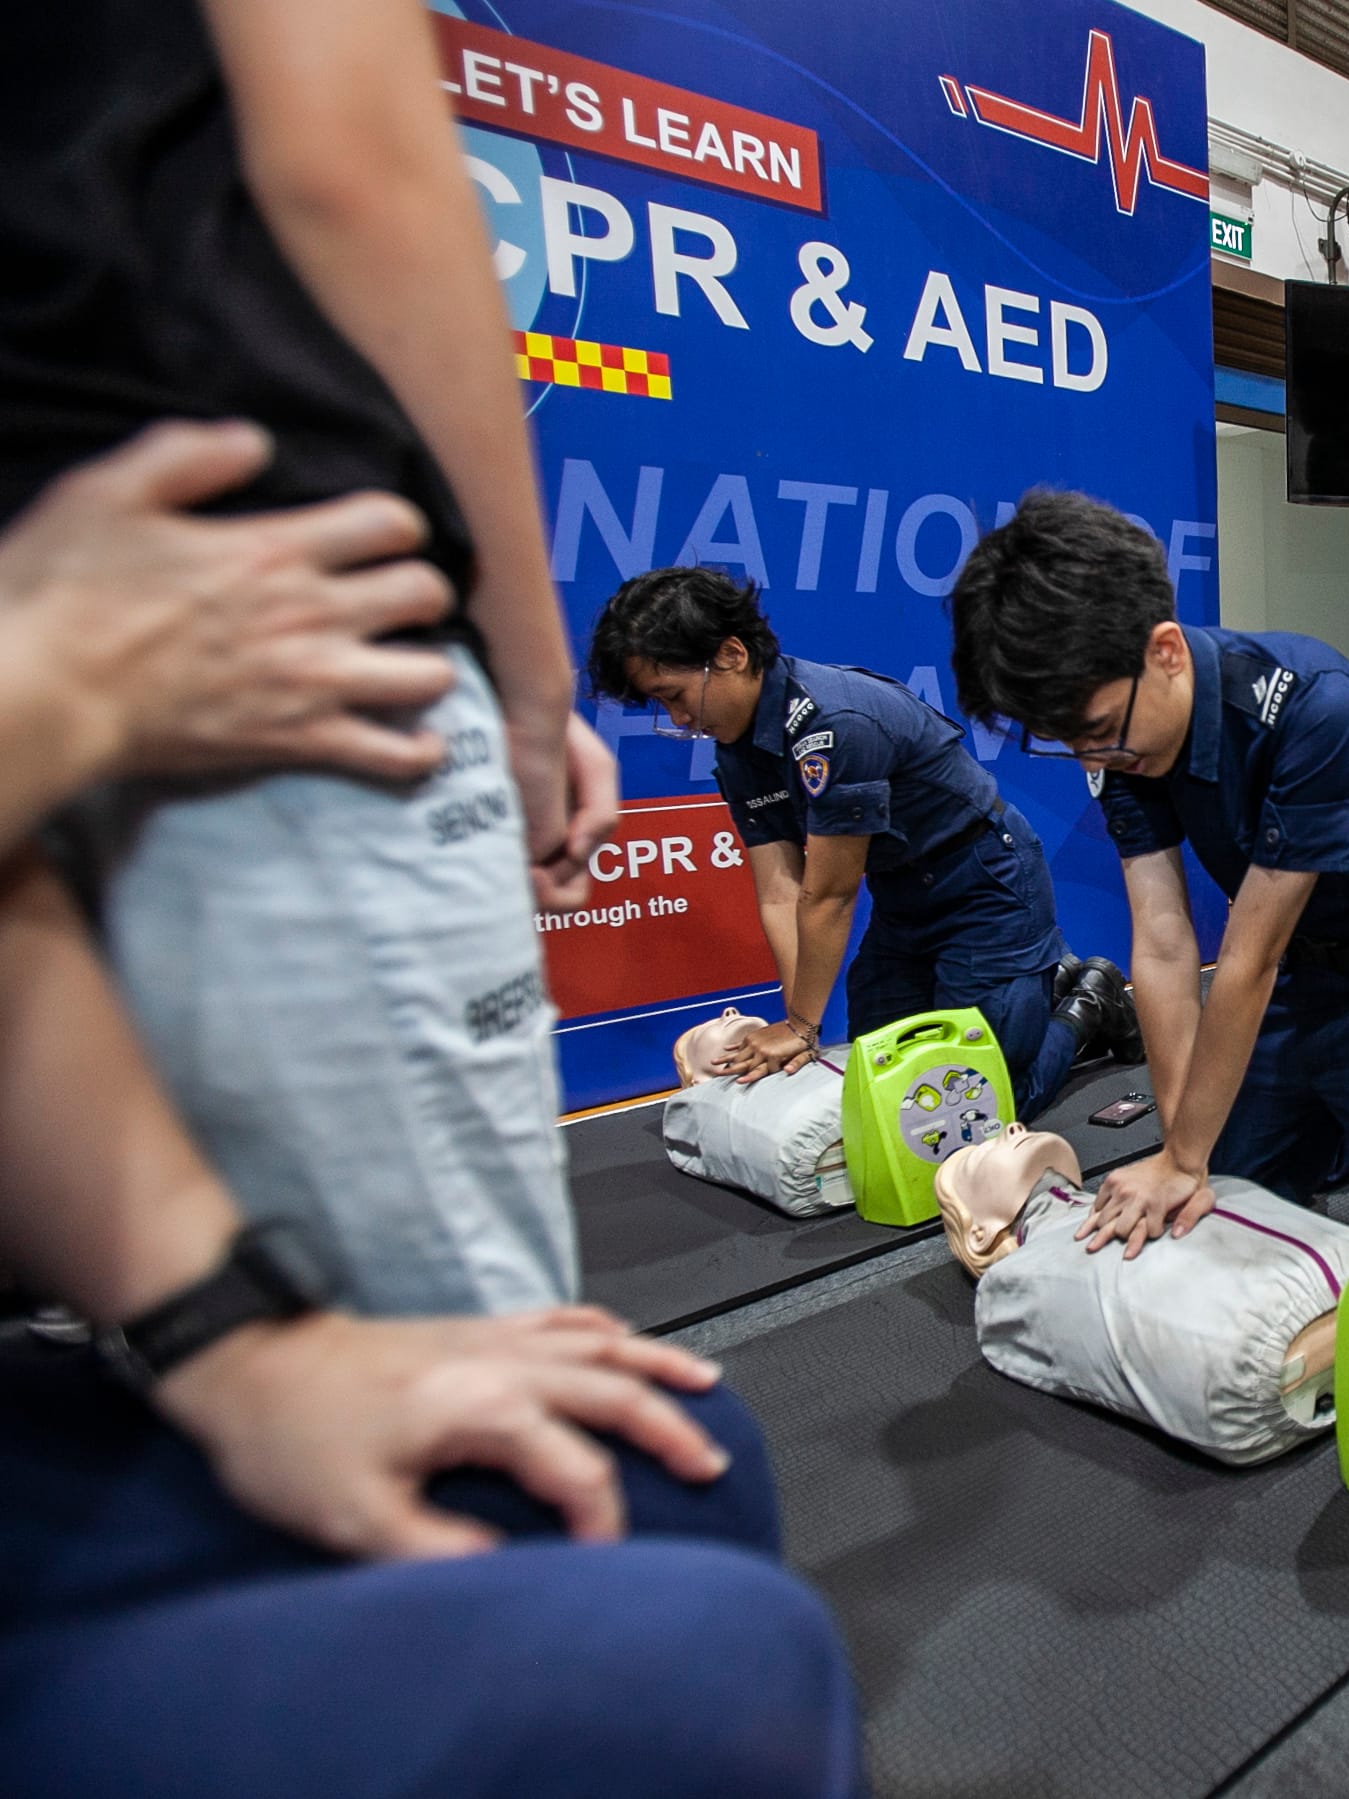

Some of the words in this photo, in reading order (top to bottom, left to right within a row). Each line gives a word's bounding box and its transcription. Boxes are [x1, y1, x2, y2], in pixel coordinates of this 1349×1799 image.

[622, 97, 802, 190] LEARN
[1211, 218, 1245, 252] EXIT
[790, 240, 875, 354] &
[902, 269, 1109, 393] AED
[1267, 670, 1295, 726] NCDCC
[588, 836, 698, 882] CPR
[710, 831, 744, 869] &
[533, 899, 641, 933] through
[648, 895, 689, 918] the
